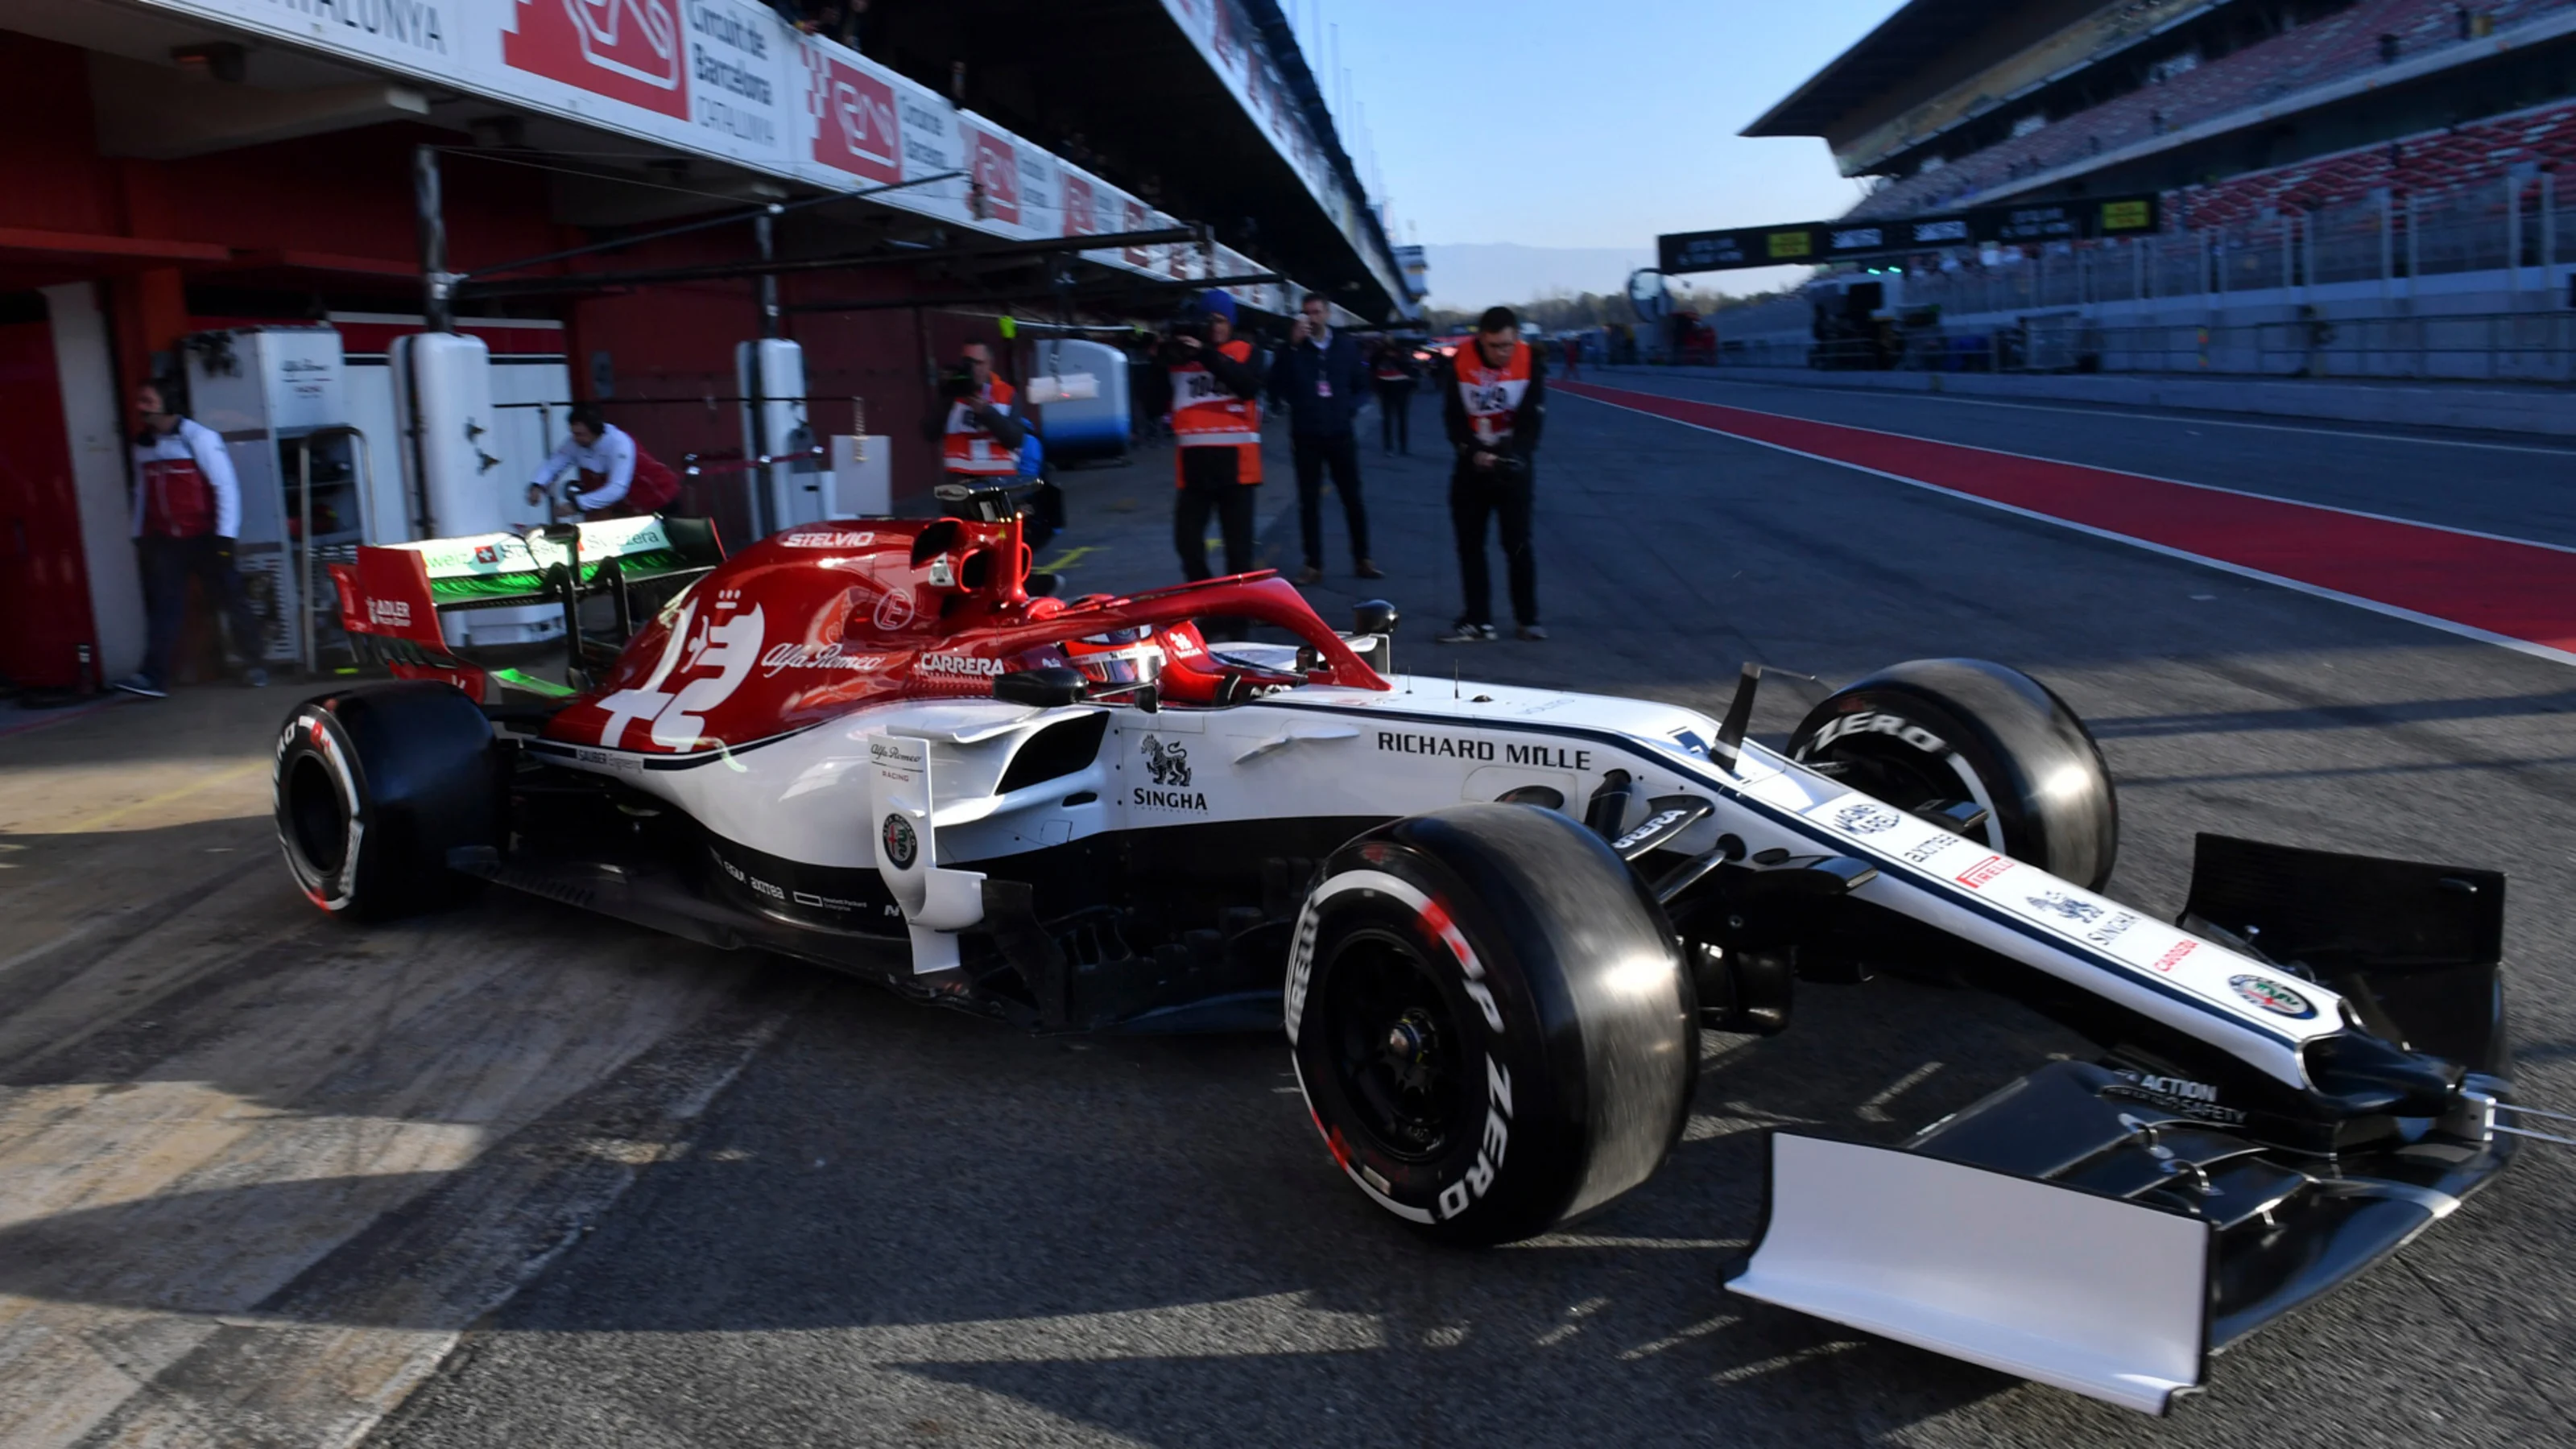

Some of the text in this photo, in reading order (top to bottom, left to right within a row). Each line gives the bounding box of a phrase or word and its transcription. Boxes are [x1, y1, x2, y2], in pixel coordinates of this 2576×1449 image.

[784, 532, 875, 548] STELVIO
[761, 643, 884, 678] Alfa Romeo
[920, 653, 1005, 675] CARRERA
[1814, 711, 1945, 753] ZERO
[870, 744, 922, 762] Alfa Romeo
[1378, 732, 1591, 770] RICHARD MILLE
[882, 770, 909, 782] RACING
[1133, 787, 1208, 810] SINGHA
[1956, 855, 2016, 889] PIRELLI
[1438, 977, 1514, 1220] P ZERO
[2140, 1074, 2217, 1102] ACTION
